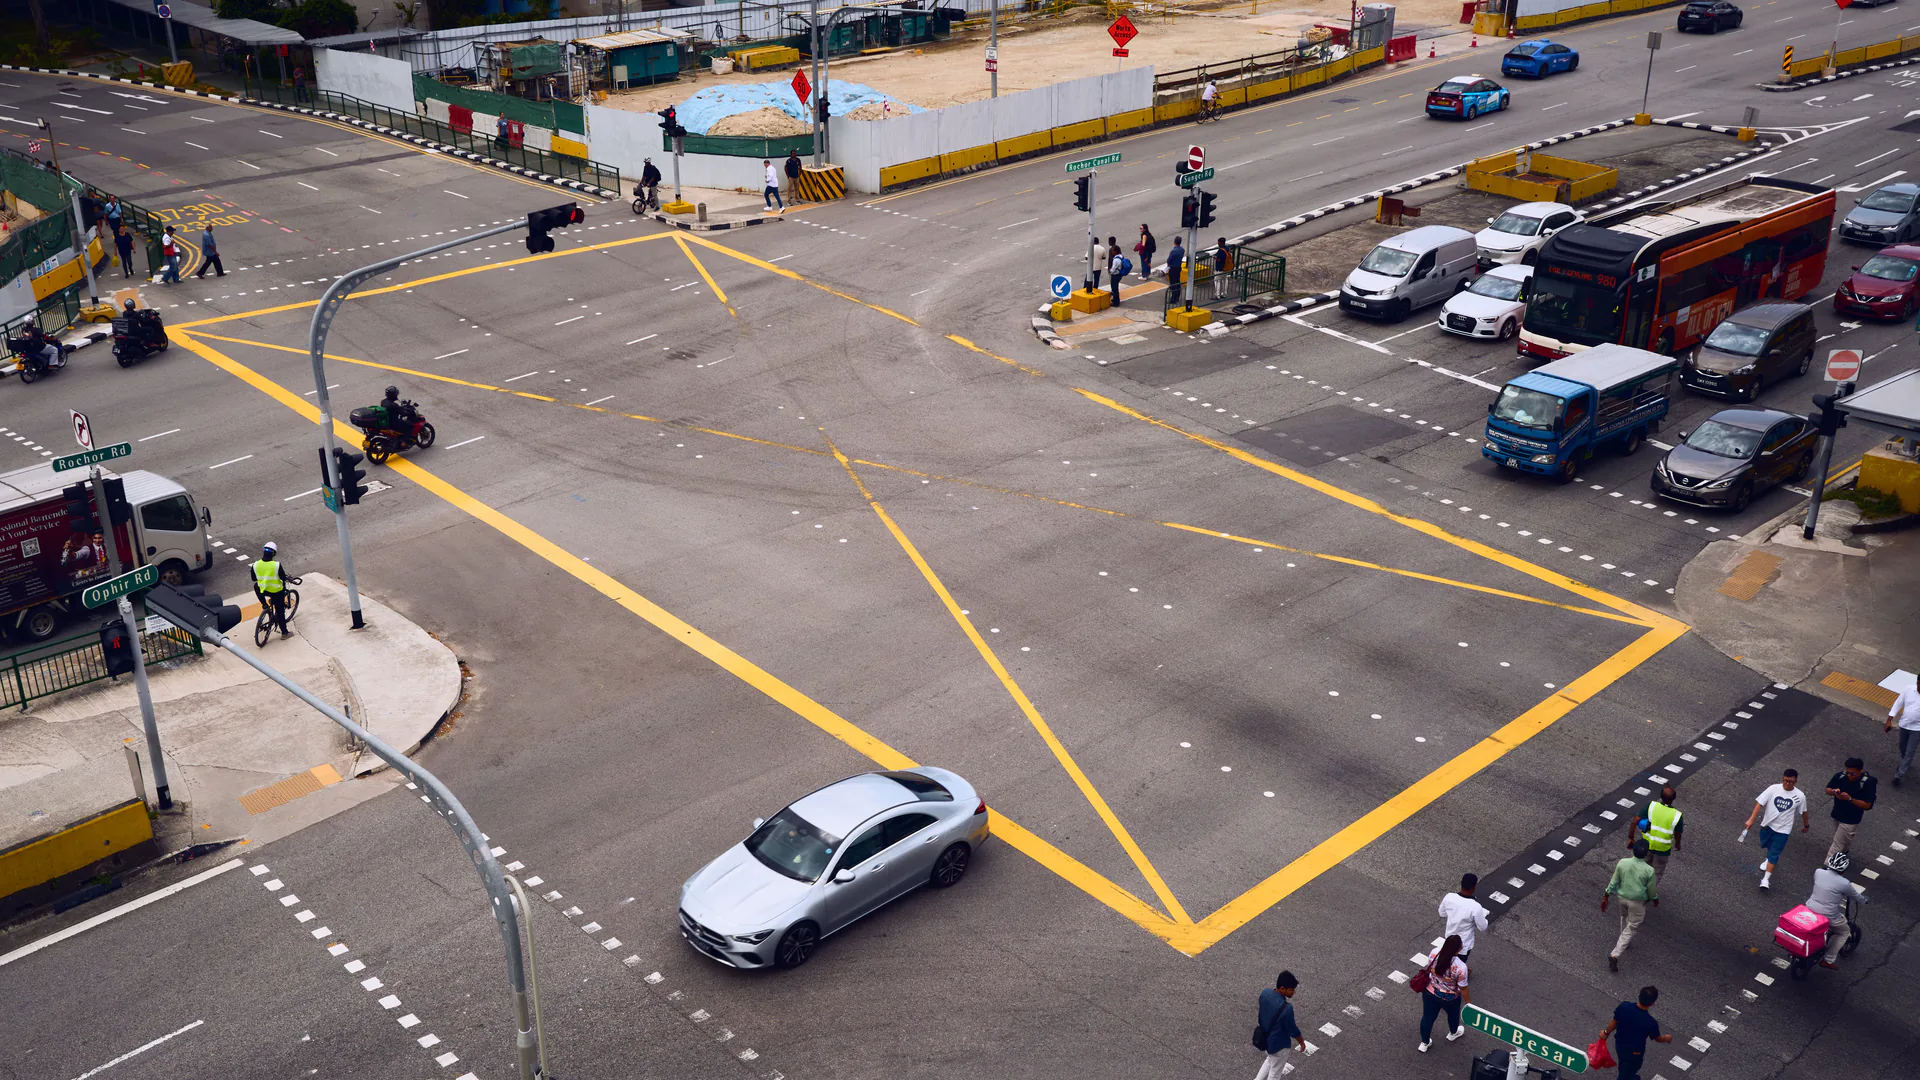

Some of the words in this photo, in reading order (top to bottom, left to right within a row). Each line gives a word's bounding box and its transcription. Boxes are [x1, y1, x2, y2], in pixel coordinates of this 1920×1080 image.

[797, 82, 806, 95] 50
[1069, 162, 1091, 172] Rochor
[1092, 158, 1110, 167] Canal
[1112, 155, 1120, 163] Rd
[1184, 172, 1204, 183] Sungei
[1205, 169, 1212, 177] Rd
[147, 202, 225, 222] 07:30
[172, 214, 250, 232] 23:00
[1597, 273, 1617, 288] 980
[59, 452, 104, 470] Rochor
[111, 445, 126, 457] Rd
[31, 508, 68, 523] Bartende
[8, 528, 28, 539] Your
[29, 519, 61, 533] Service
[92, 580, 129, 602] Ophir
[135, 569, 151, 584] Rd
[1472, 1013, 1502, 1037] Jln
[1512, 1029, 1574, 1066] Besar
